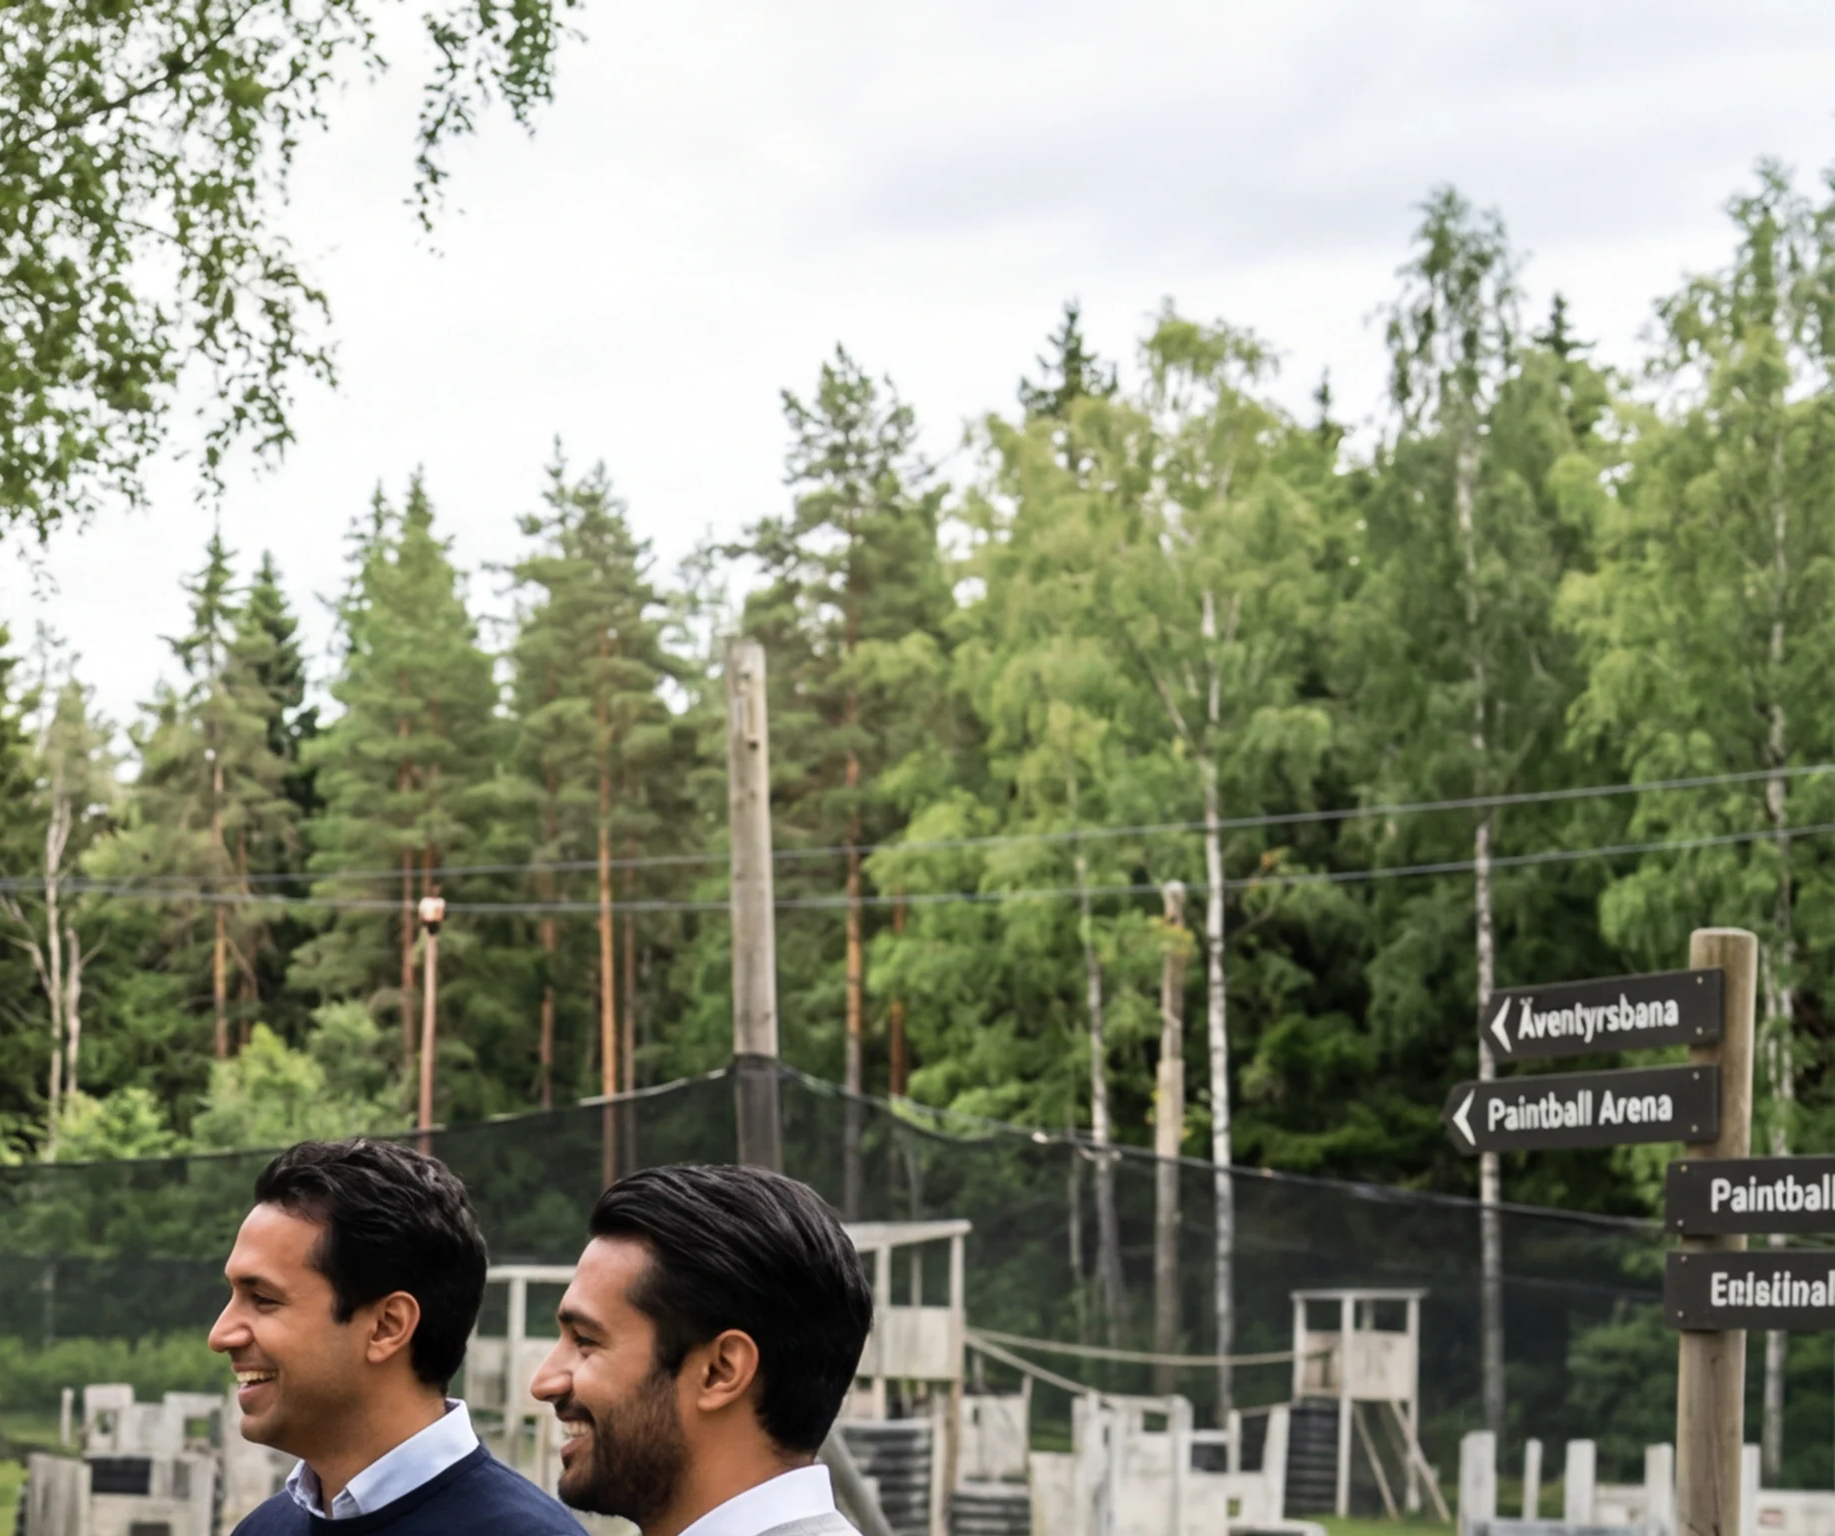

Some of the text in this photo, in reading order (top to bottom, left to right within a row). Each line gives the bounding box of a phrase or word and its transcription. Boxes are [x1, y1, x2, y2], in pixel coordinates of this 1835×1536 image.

[1517, 994, 1679, 1042] Äventyrsbana
[1488, 1089, 1673, 1132] Paintball Arena
